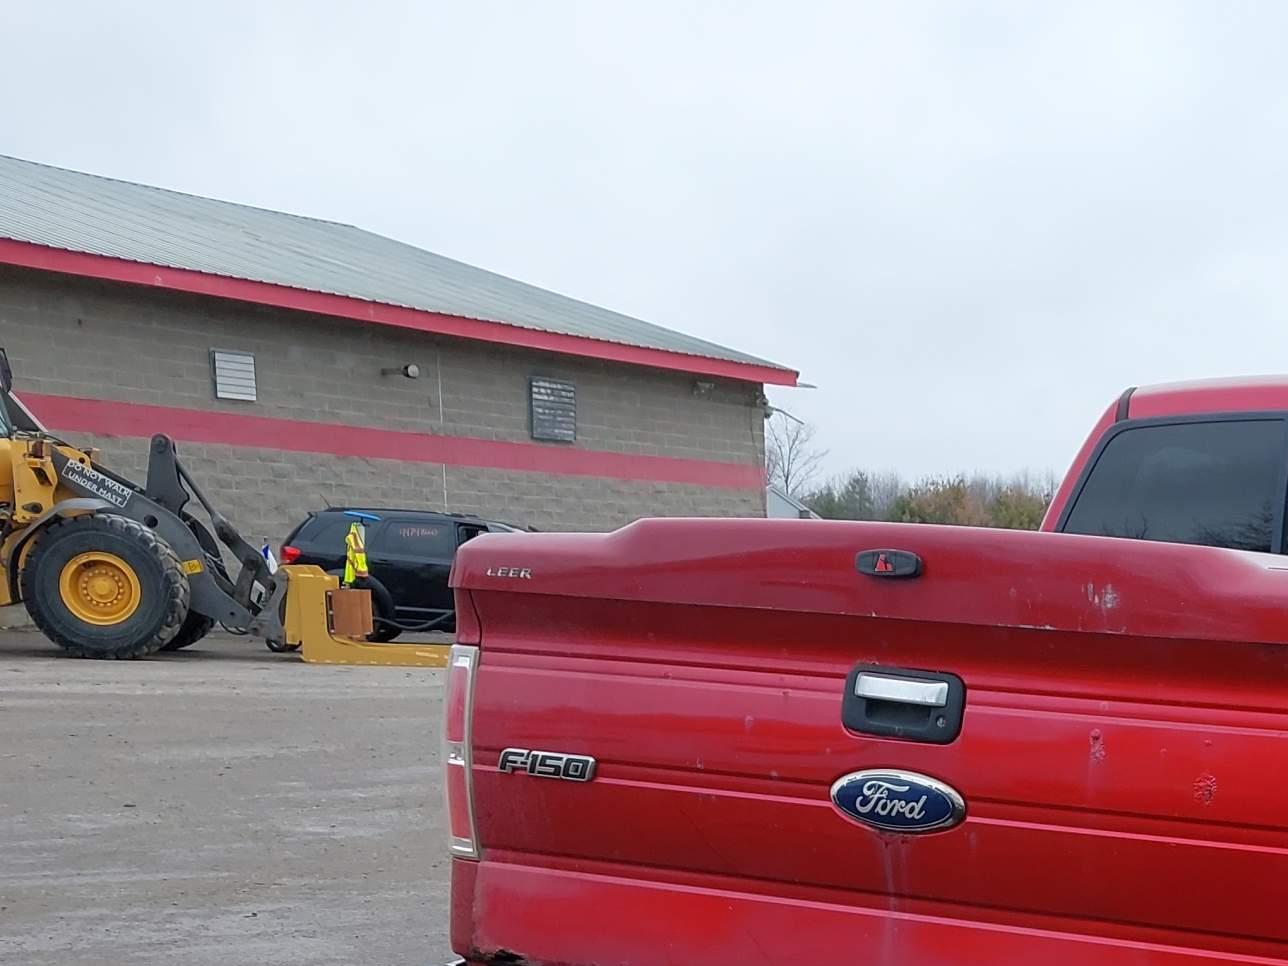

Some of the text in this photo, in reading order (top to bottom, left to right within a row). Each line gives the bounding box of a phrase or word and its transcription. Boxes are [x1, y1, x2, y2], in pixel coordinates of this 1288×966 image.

[67, 460, 82, 472] DO
[83, 467, 102, 482] NOT
[68, 471, 123, 505] UNDER MAST
[486, 566, 532, 580] LEER
[855, 780, 928, 820] Ford
